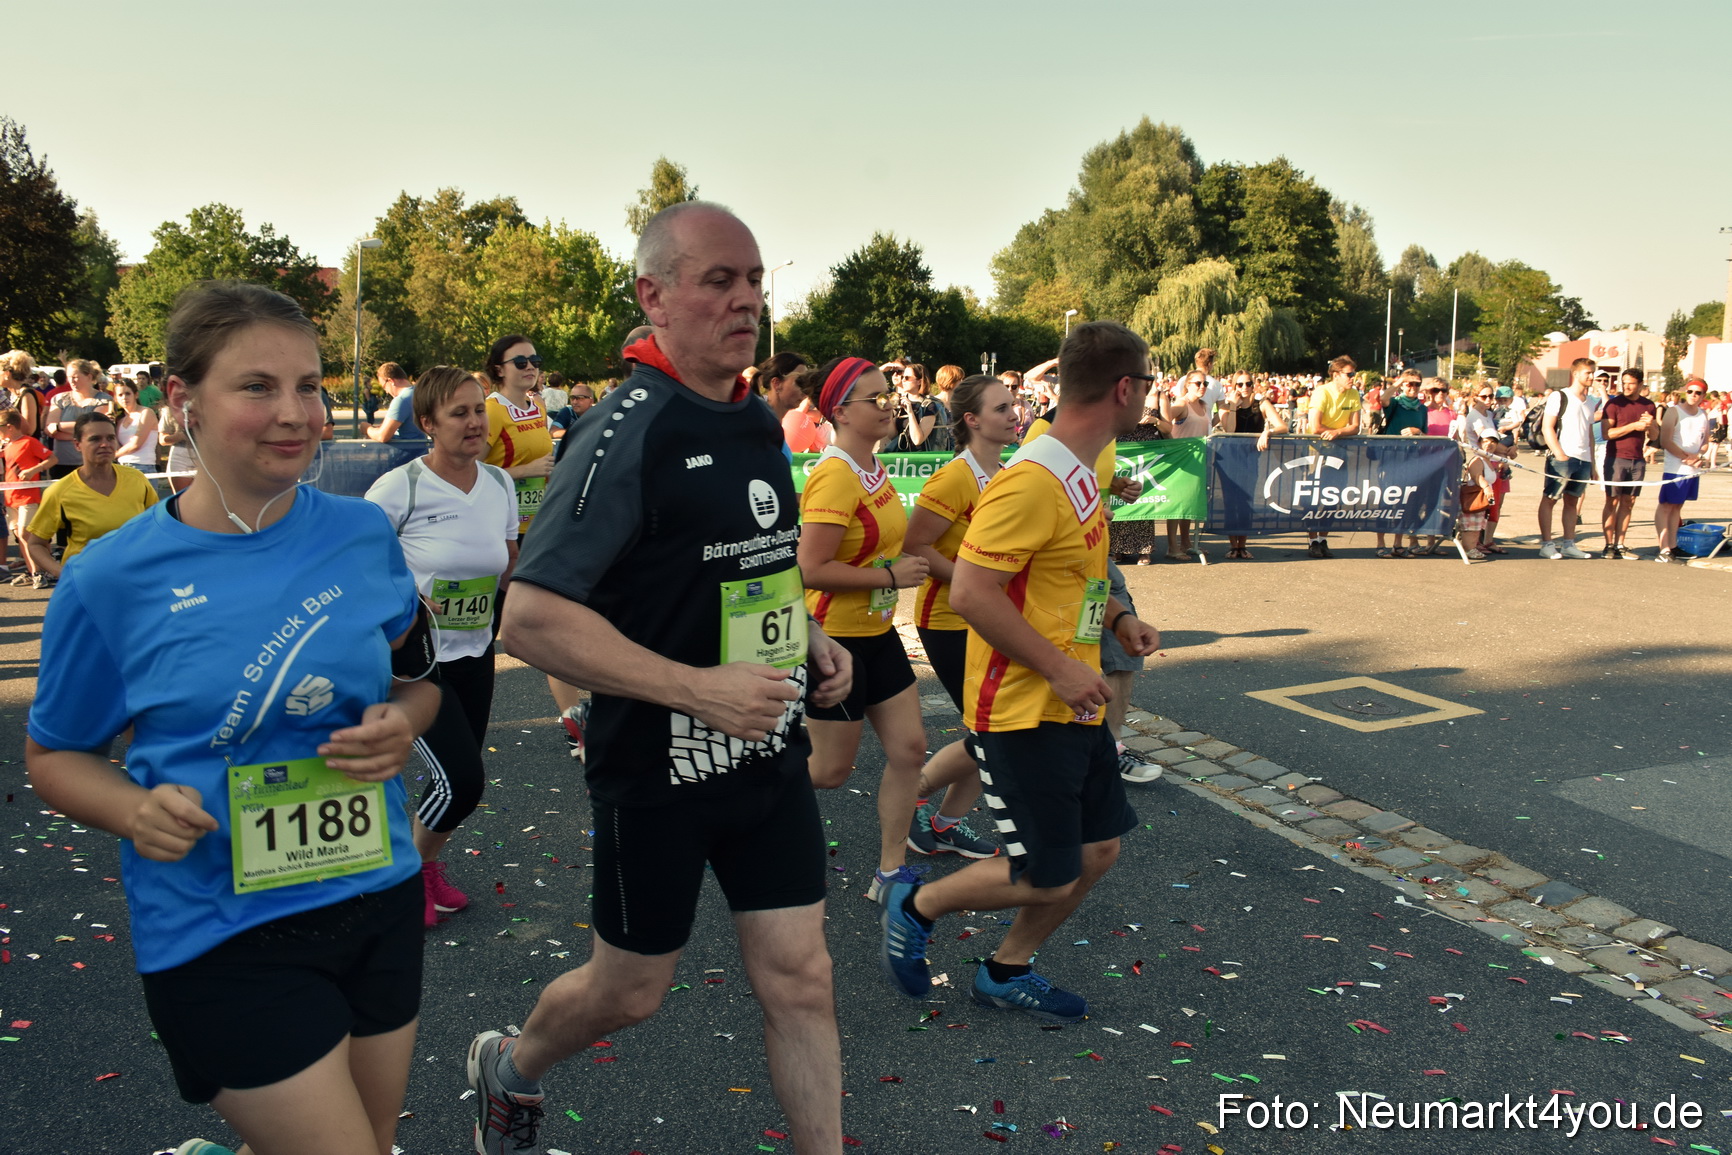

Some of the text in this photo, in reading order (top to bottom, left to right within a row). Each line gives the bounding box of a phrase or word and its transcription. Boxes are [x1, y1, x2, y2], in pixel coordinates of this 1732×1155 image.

[516, 424, 534, 433] MAX
[685, 454, 713, 470] JAKO
[516, 490, 543, 504] 1326
[873, 491, 894, 509] MAX
[1292, 479, 1417, 506] Fischer
[1301, 509, 1405, 521] AUTOMOBILE
[170, 595, 208, 613] erima
[440, 595, 488, 616] 1140
[761, 605, 793, 645] 67
[756, 647, 784, 658] Hagen
[210, 584, 343, 749] Team Schick Bau
[255, 794, 371, 852] 1188
[286, 843, 349, 862] Wild Maria
[244, 867, 276, 878] Matthias
[278, 862, 302, 873] Schick
